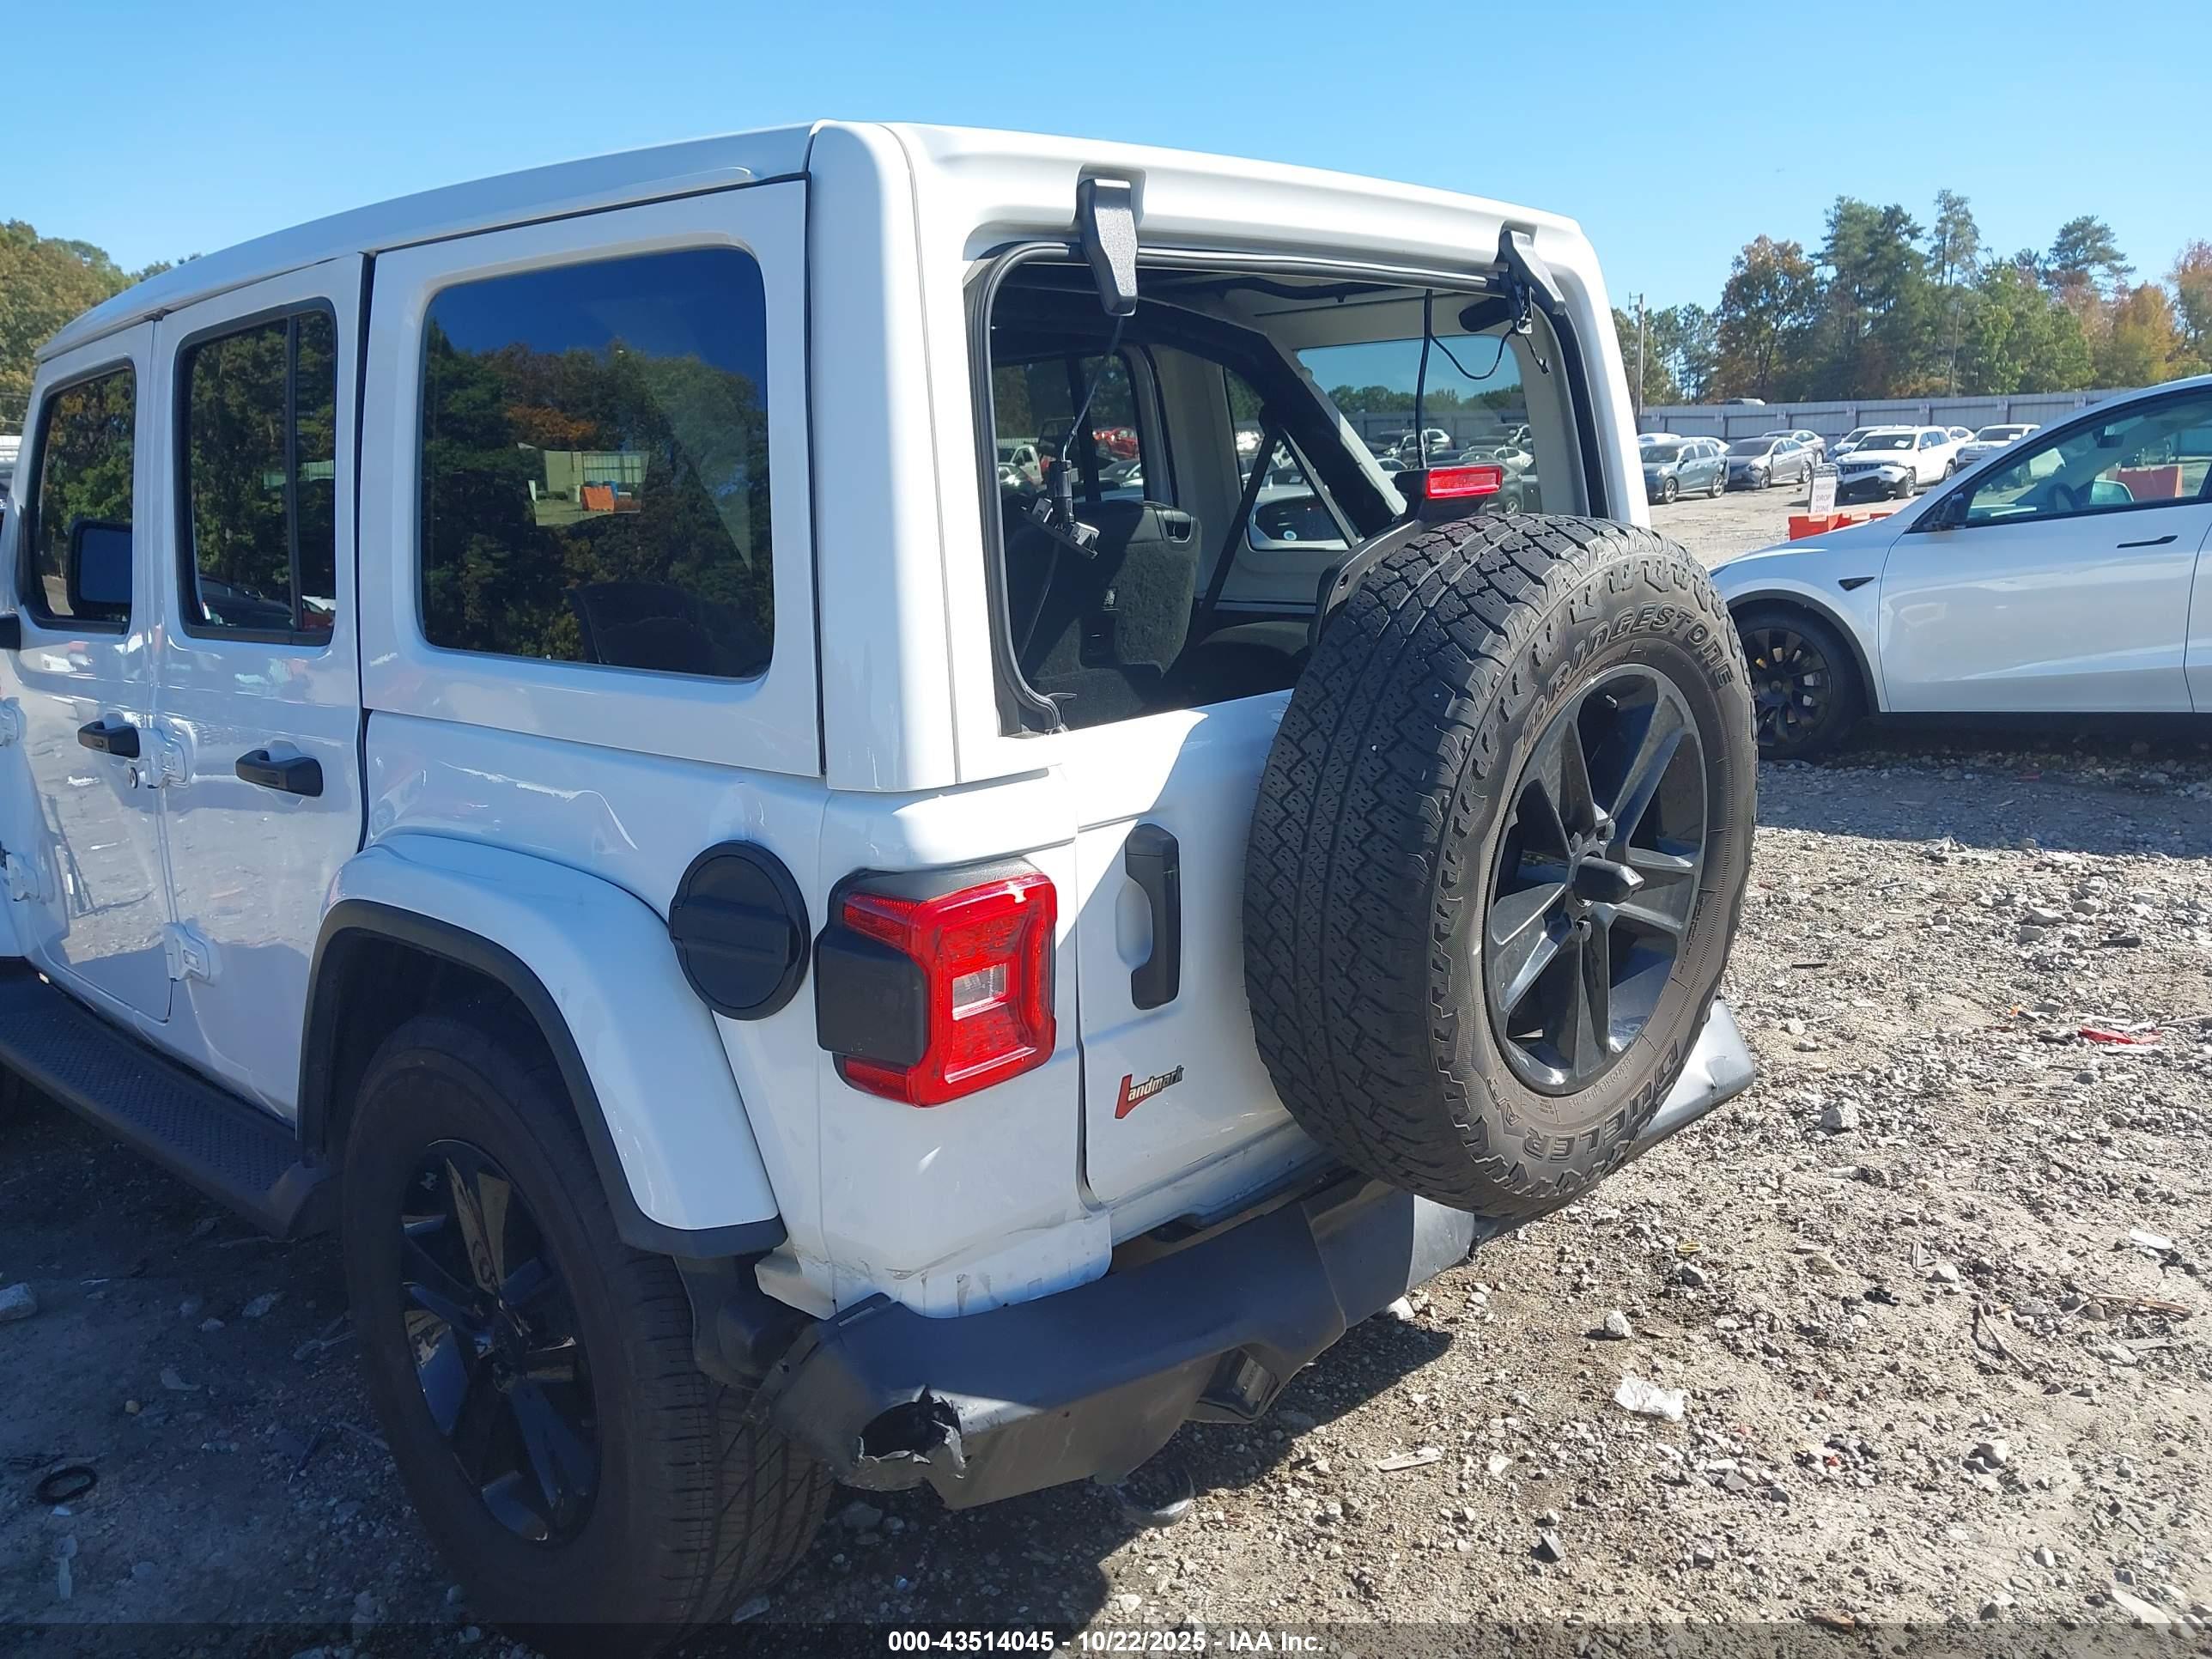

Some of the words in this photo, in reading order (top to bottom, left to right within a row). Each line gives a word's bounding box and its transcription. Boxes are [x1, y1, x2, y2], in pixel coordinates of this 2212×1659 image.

[1522, 601, 1735, 746] BRIDGESTONE
[1115, 1064, 1184, 1119] Landmark
[1523, 1038, 1678, 1163] DUELER
